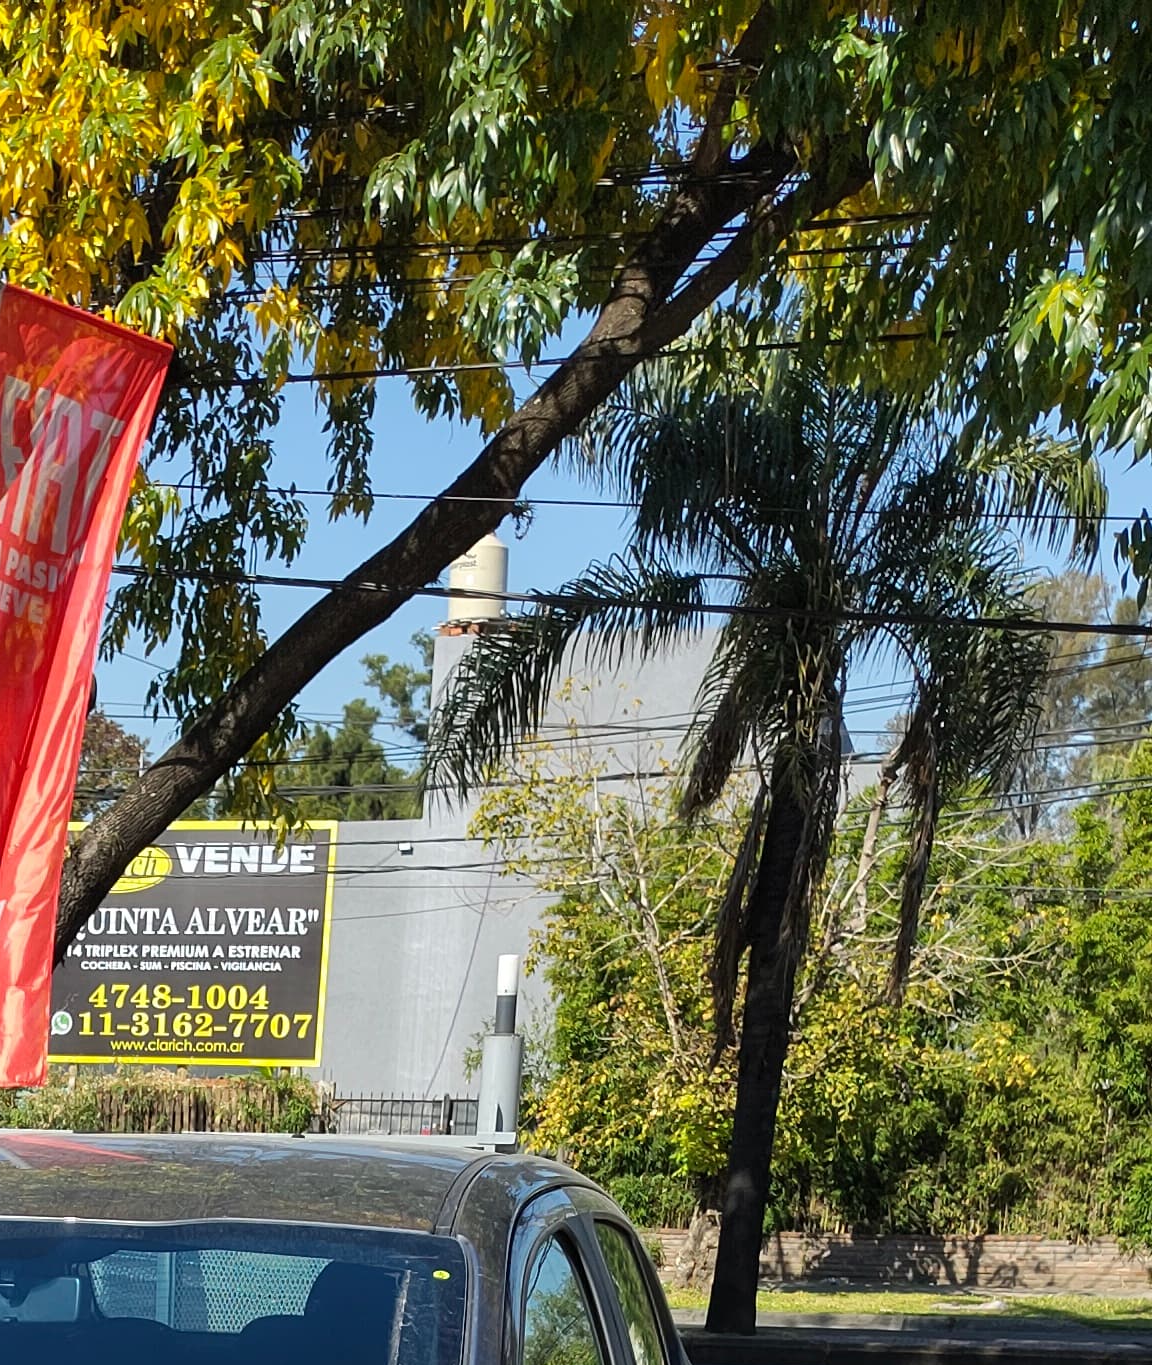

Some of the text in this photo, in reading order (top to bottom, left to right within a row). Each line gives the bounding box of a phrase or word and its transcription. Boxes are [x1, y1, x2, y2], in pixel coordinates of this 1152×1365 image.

[4, 542, 88, 593] PASI
[175, 843, 316, 873] VENDE
[76, 907, 319, 940] UINTA ALVEAR"
[85, 945, 138, 958] TRIPLEX
[142, 945, 209, 959] PREMIUM
[212, 945, 225, 959] A
[228, 945, 301, 959] ESTRENAR
[80, 960, 131, 971] COCHERA
[140, 961, 162, 971] SUM
[171, 961, 212, 971] PISCINA
[220, 961, 283, 972] VIGILANCIA
[88, 983, 269, 1010] 4748-1004
[78, 1011, 313, 1039] 11-3162-7707
[110, 1038, 244, 1053] www.clarich.com.ar
